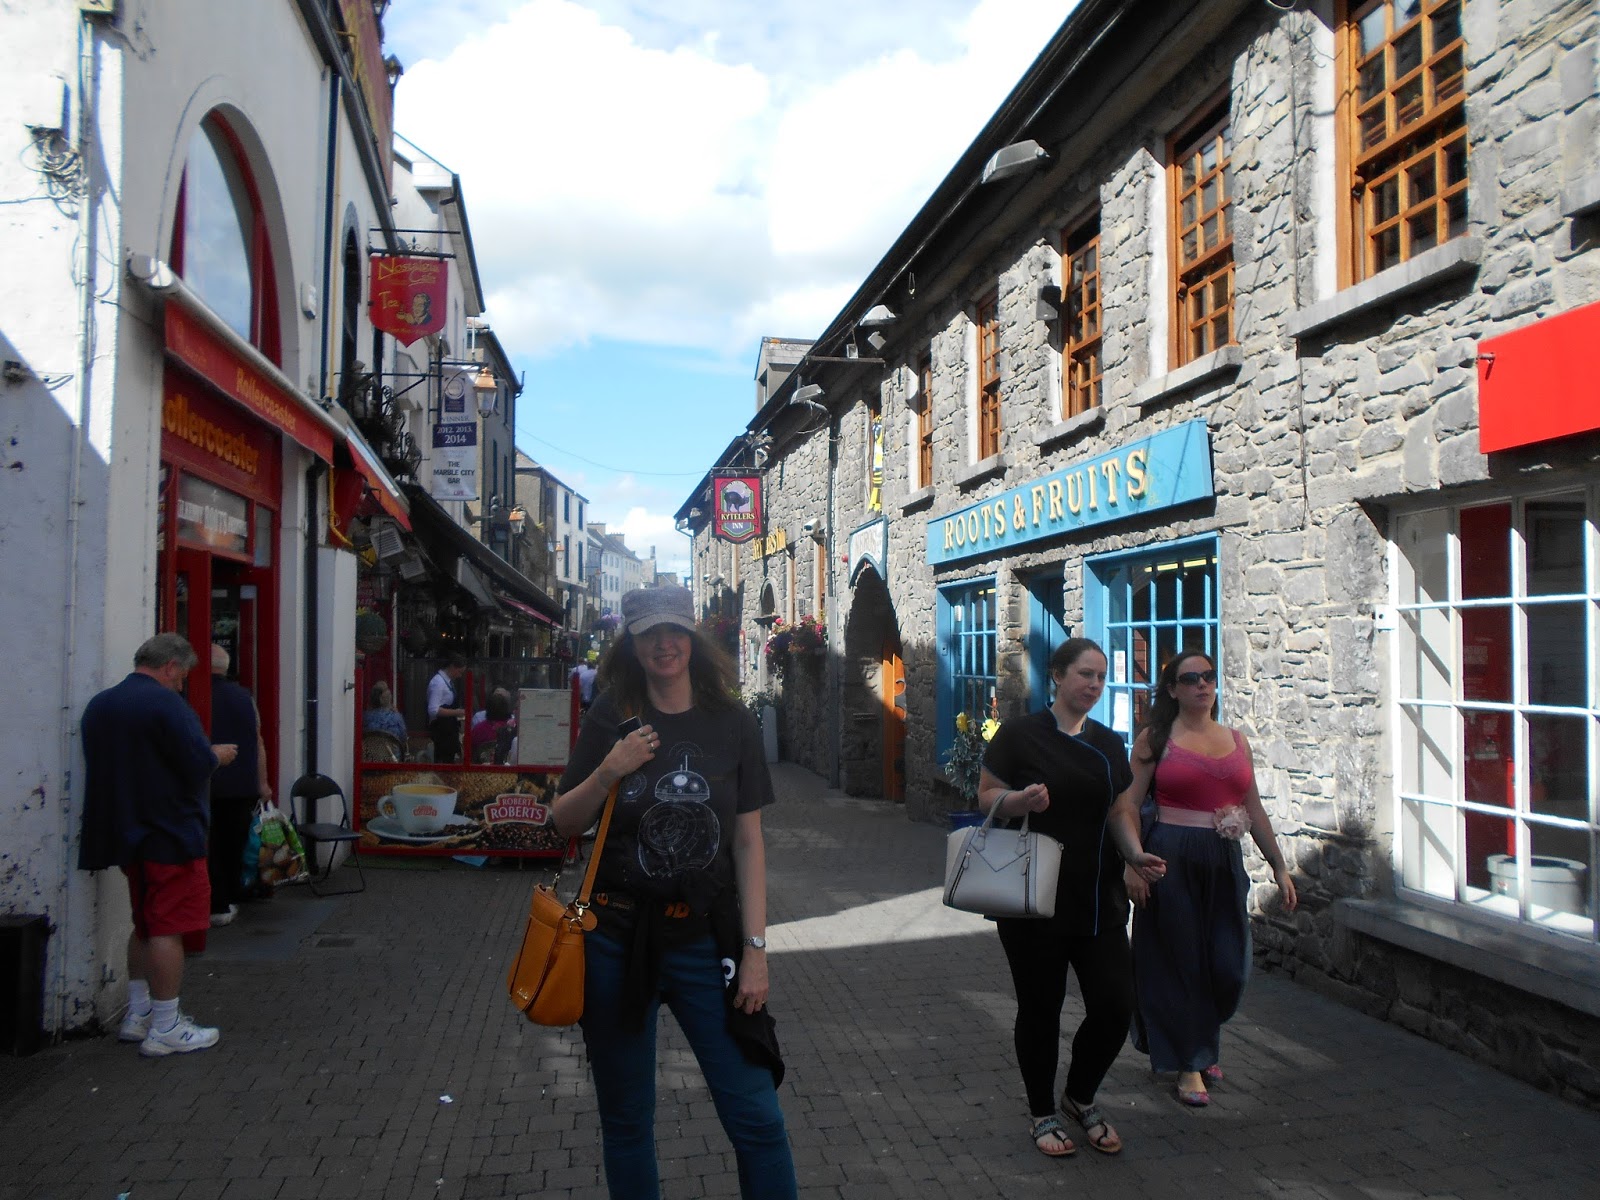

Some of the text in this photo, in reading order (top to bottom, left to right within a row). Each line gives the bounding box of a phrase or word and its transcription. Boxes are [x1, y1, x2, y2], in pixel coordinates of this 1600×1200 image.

[236, 366, 297, 432] Rollercoaster
[162, 393, 260, 477] ollercoaster
[444, 434, 467, 444] 2014
[943, 498, 1007, 550] ROOTS
[1012, 494, 1026, 532] &
[1031, 447, 1148, 529] FRUITS
[732, 521, 744, 529] INN
[502, 797, 533, 806] ROBERT
[490, 806, 542, 820] ROBERTS
